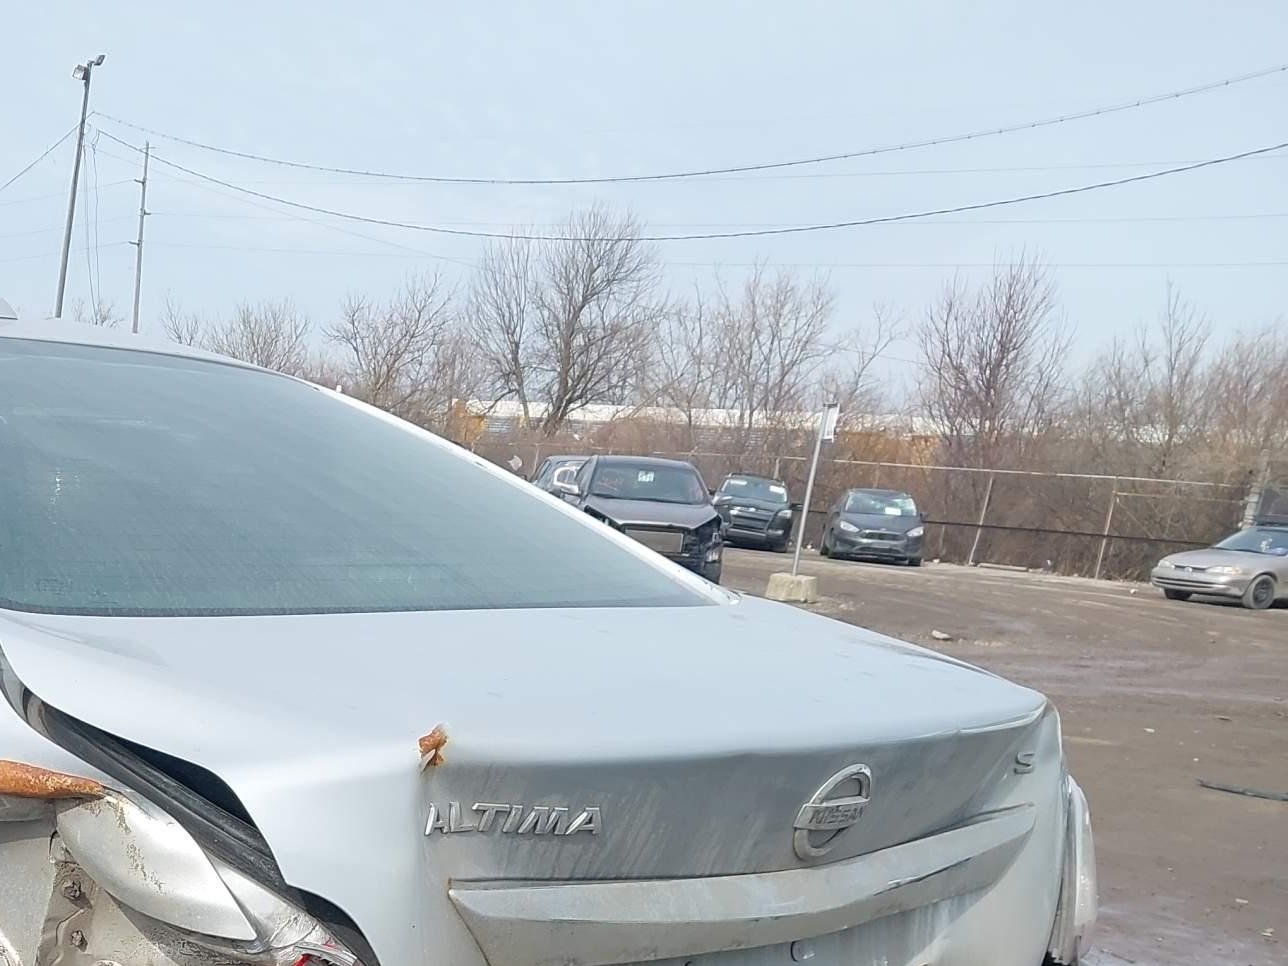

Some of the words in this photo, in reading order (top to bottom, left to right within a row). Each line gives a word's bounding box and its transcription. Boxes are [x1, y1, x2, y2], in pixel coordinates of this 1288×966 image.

[1014, 751, 1034, 775] S
[424, 801, 601, 836] ALTIMA
[808, 804, 863, 825] NISSAN
